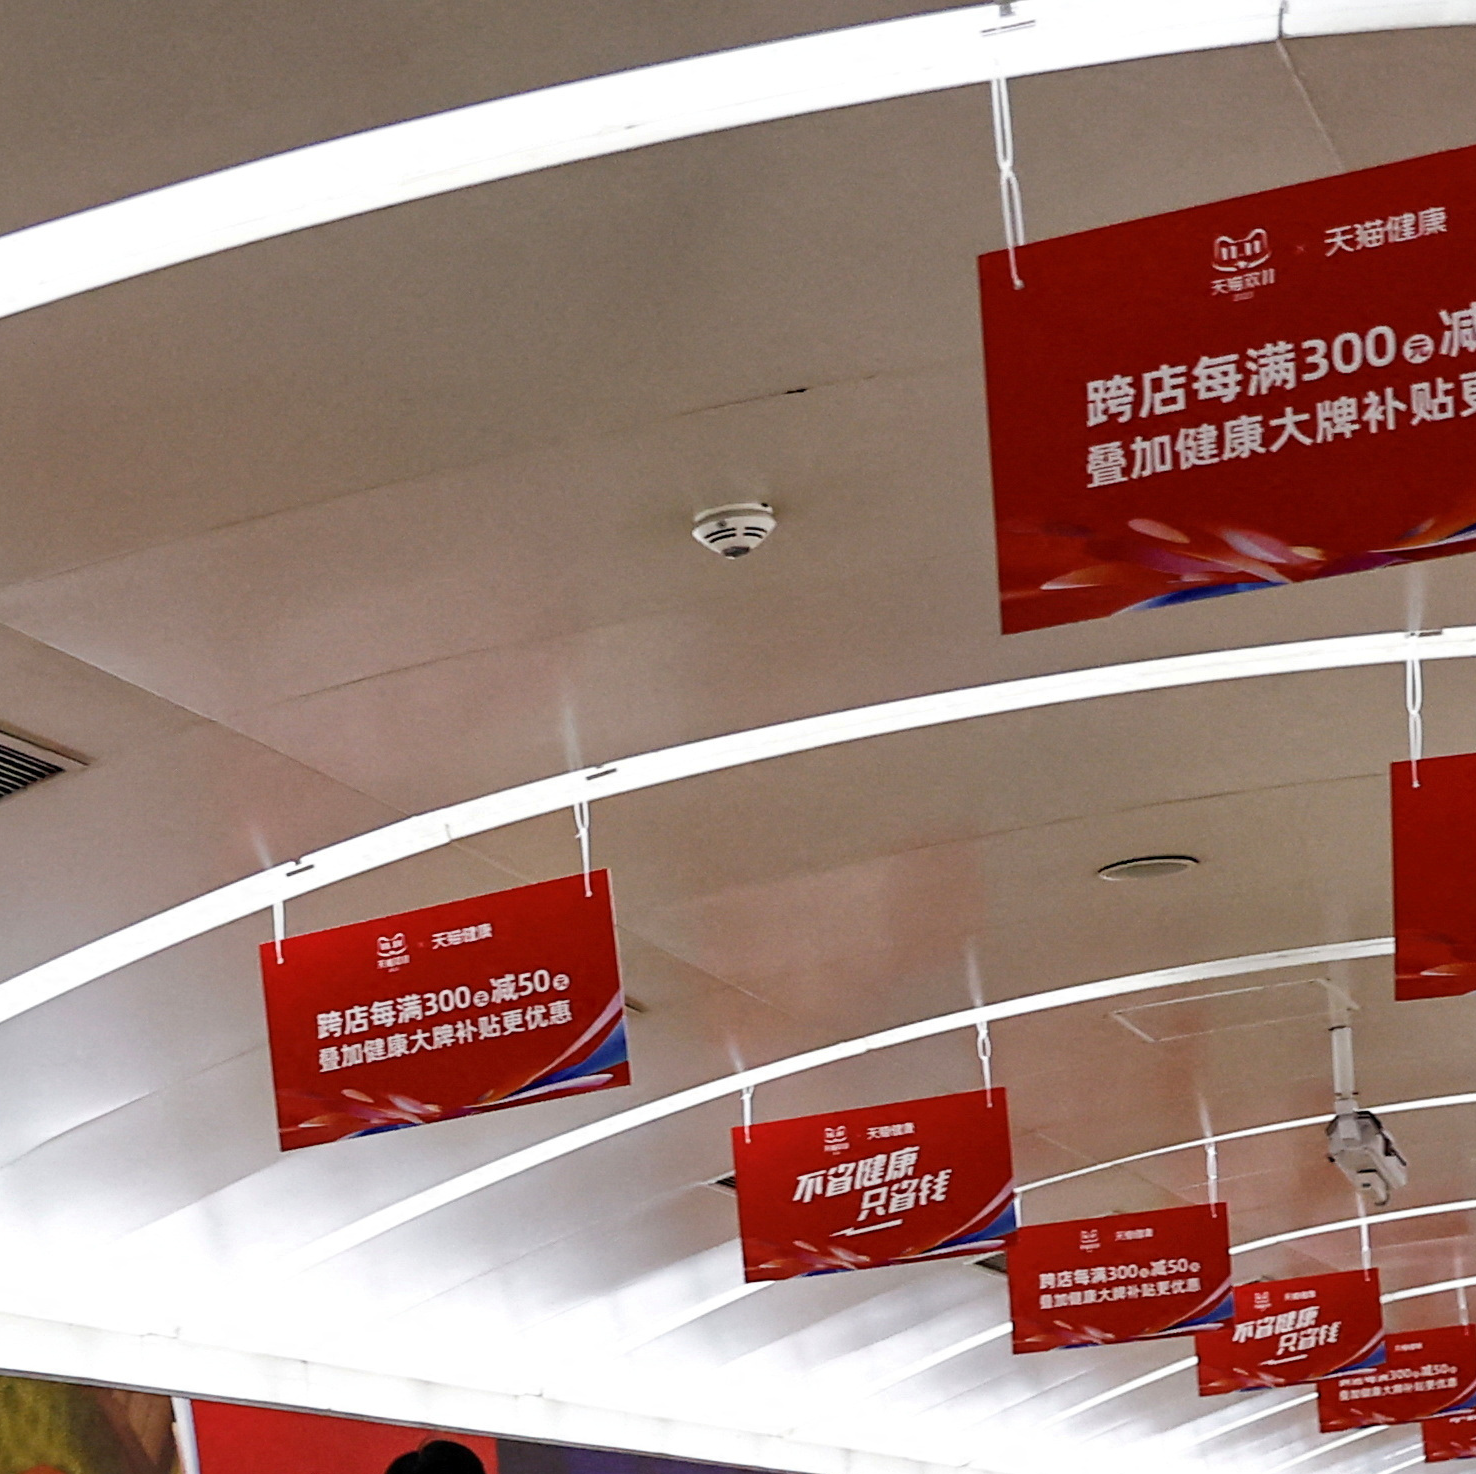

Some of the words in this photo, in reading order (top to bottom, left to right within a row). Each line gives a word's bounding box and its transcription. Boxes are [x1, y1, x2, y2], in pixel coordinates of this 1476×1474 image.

[1324, 206, 1448, 257] 天猫健康
[318, 999, 573, 1073] 叠加健康大牌补贴更优惠
[792, 1145, 920, 1203] 不省健康
[856, 1168, 953, 1222] 只省钱
